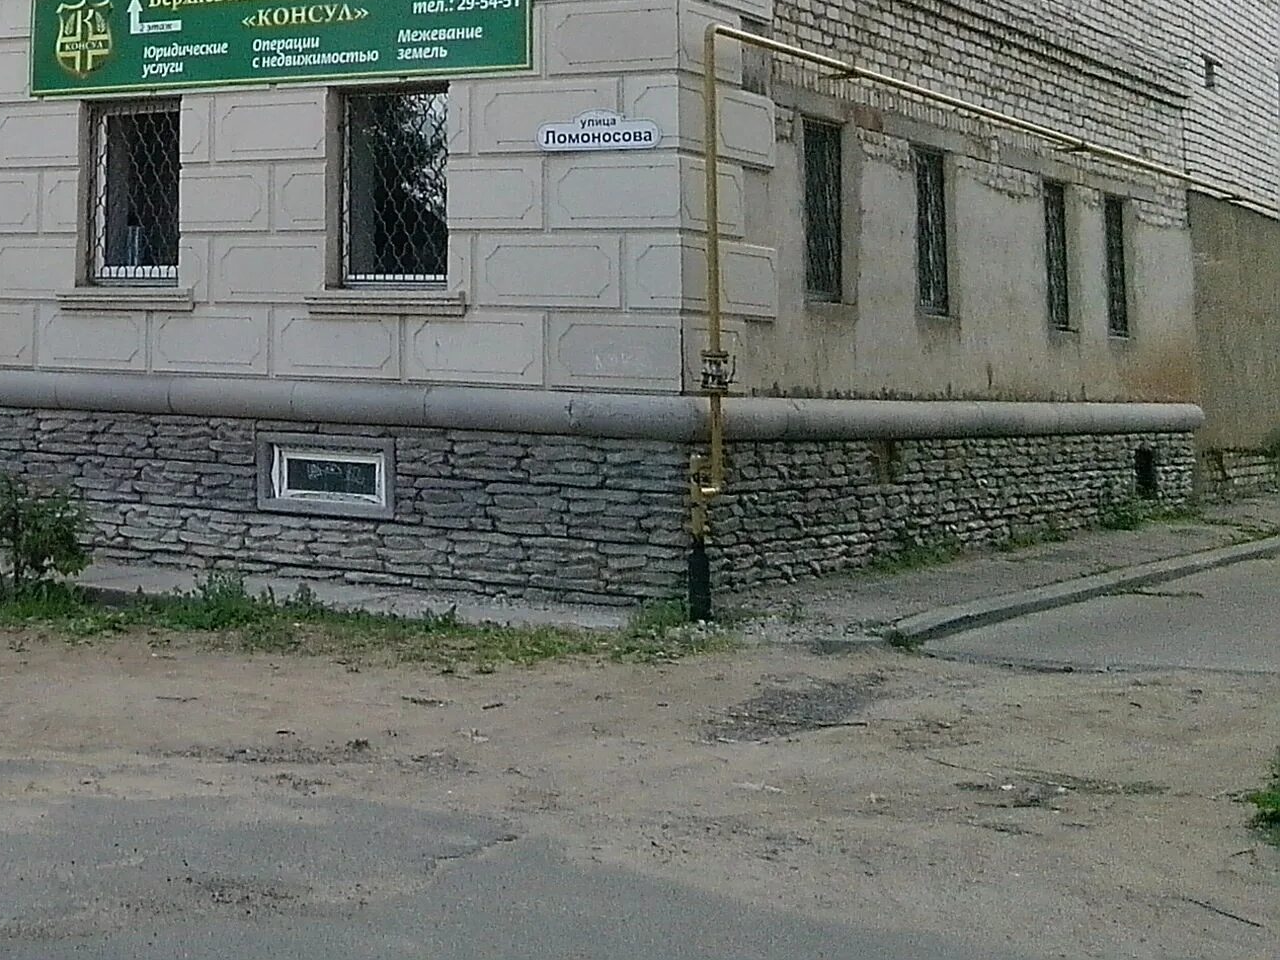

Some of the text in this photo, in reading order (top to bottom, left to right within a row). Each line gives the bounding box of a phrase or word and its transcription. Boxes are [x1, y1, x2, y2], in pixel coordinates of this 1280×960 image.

[241, 3, 369, 28] «КОНСУЛ»
[397, 26, 483, 44] Межевание
[65, 41, 104, 51] КОНСУЛ
[143, 42, 229, 61] Юридические
[252, 36, 320, 53] Операции
[396, 45, 448, 61] земель
[251, 49, 379, 69] с недвижимостью
[141, 61, 184, 79] услуги
[580, 117, 617, 129] улица
[544, 130, 652, 145] Ломоносова
